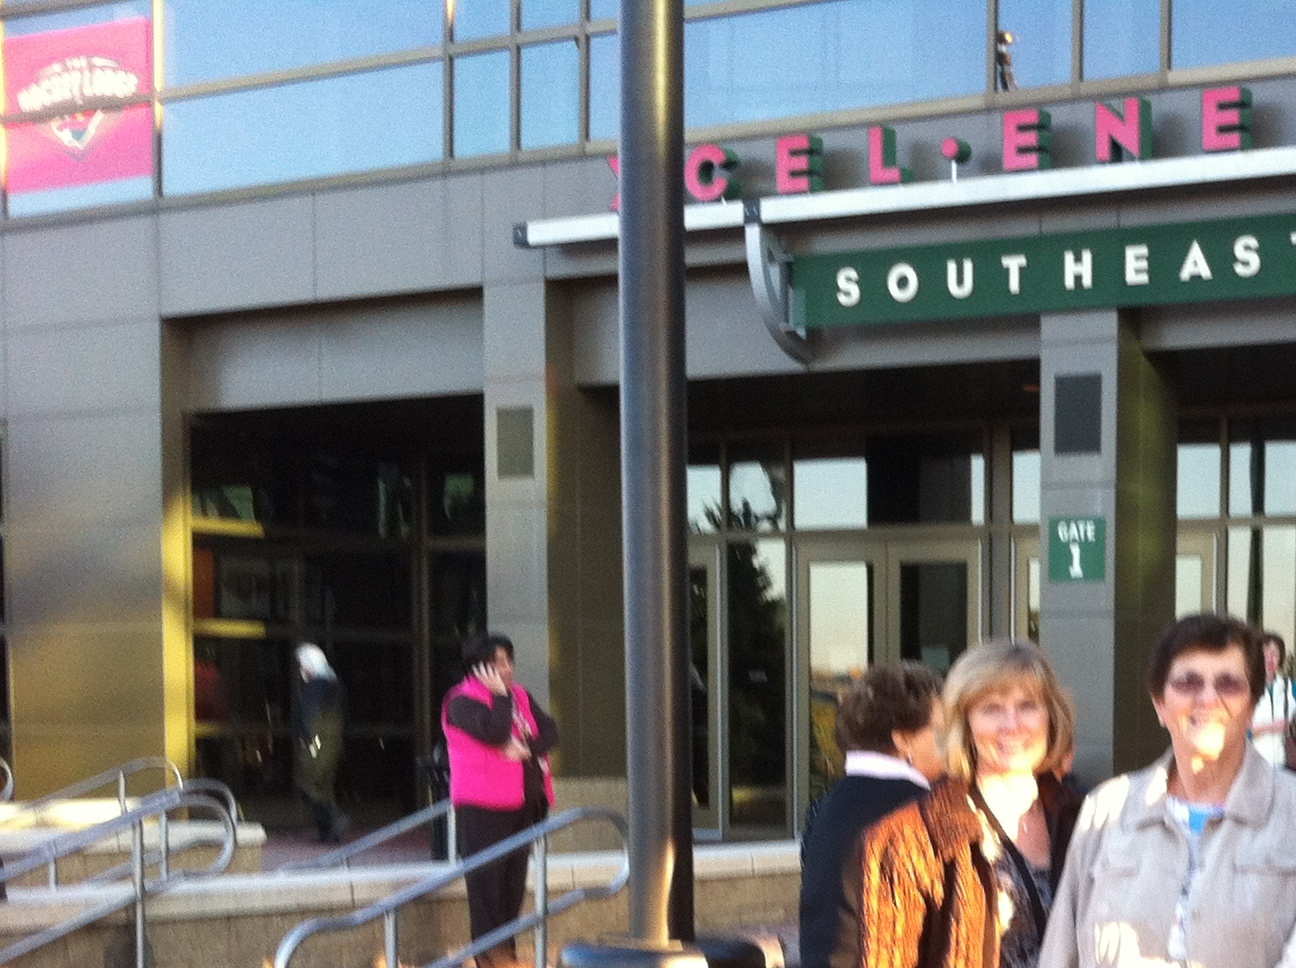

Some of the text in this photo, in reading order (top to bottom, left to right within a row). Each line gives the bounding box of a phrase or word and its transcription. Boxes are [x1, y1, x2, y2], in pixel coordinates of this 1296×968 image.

[608, 125, 907, 212] CEL
[1058, 520, 1096, 542] GATE
[1069, 543, 1083, 578] 1
